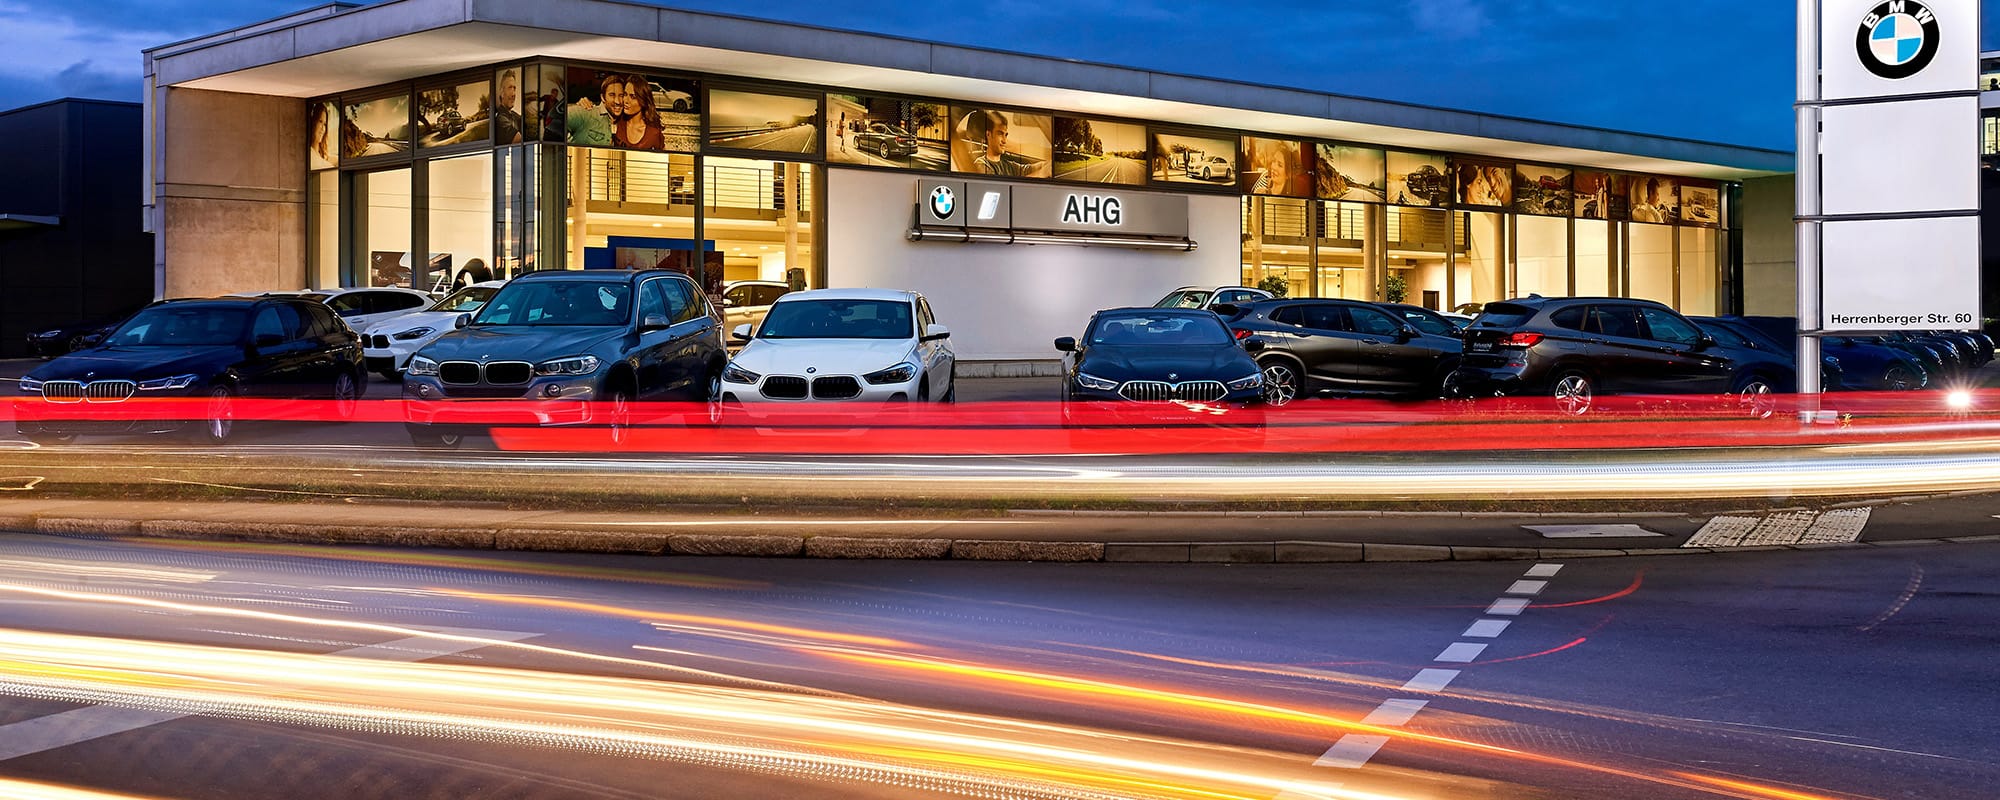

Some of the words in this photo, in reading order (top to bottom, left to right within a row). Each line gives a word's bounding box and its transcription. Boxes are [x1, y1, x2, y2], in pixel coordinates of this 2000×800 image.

[1862, 0, 1935, 29] BMW
[1063, 195, 1120, 225] AHG
[1831, 314, 1923, 325] Herrenberger
[1927, 313, 1950, 324] Str.
[1954, 313, 1972, 323] 60
